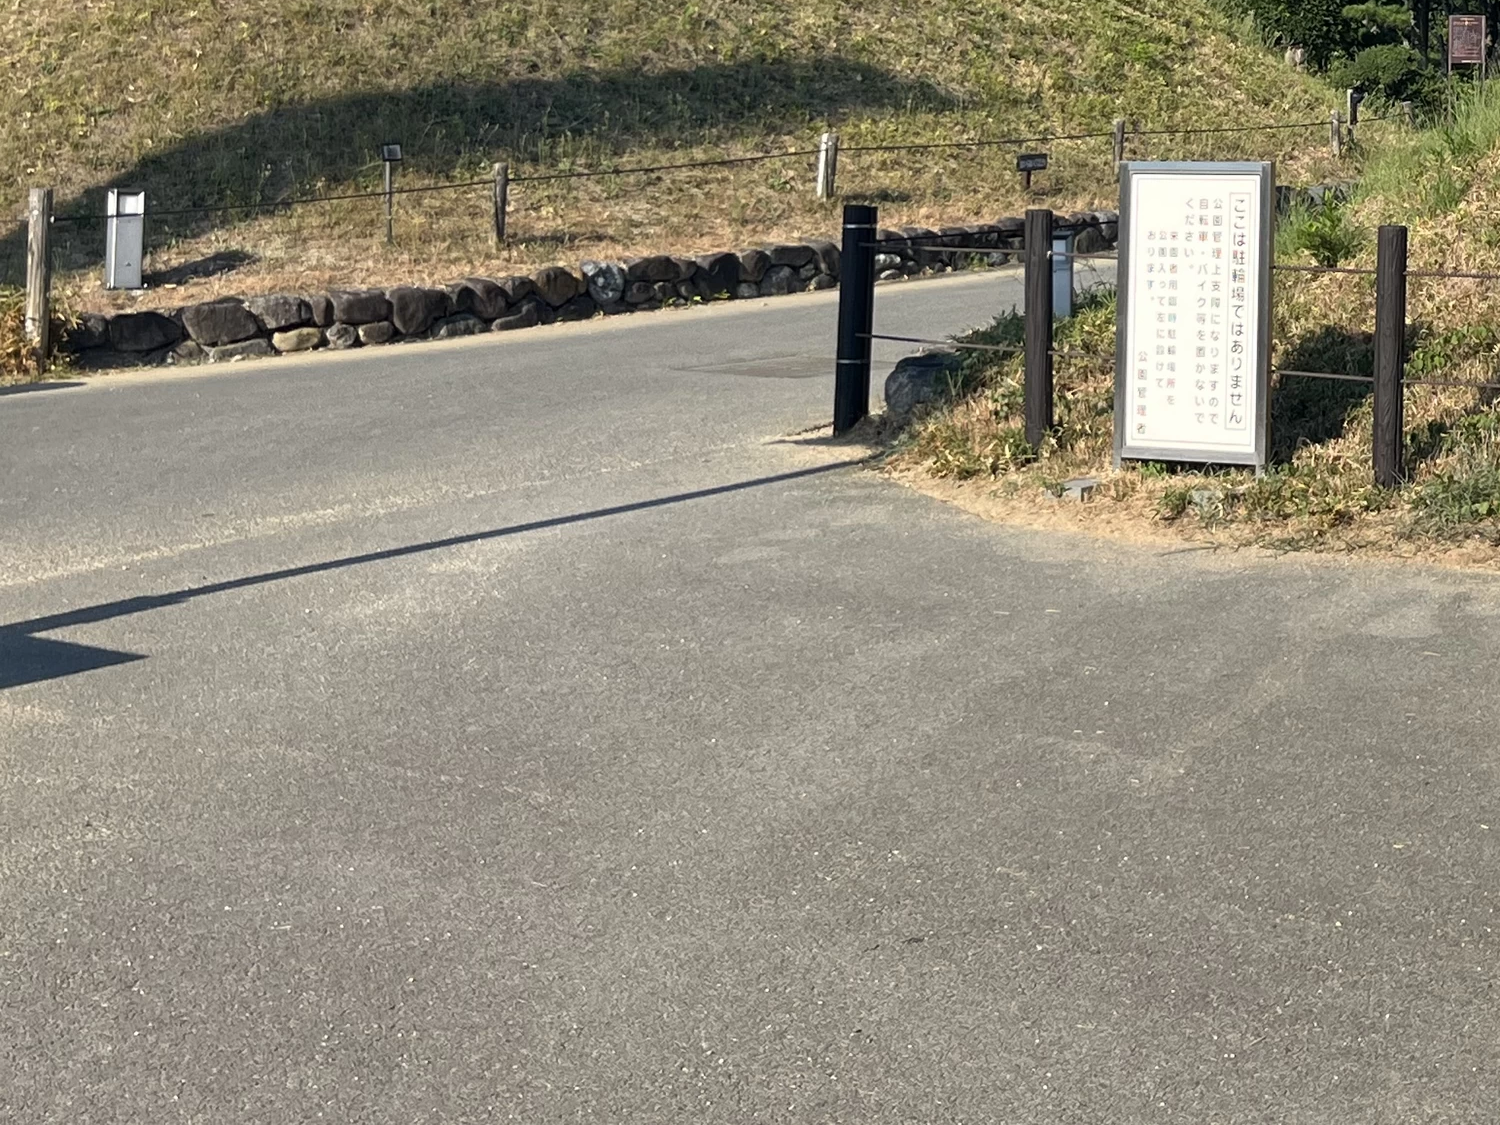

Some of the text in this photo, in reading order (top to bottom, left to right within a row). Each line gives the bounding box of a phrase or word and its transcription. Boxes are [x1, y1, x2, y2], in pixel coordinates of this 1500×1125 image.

[1229, 198, 1247, 424] ここは駐輪場ではありません
